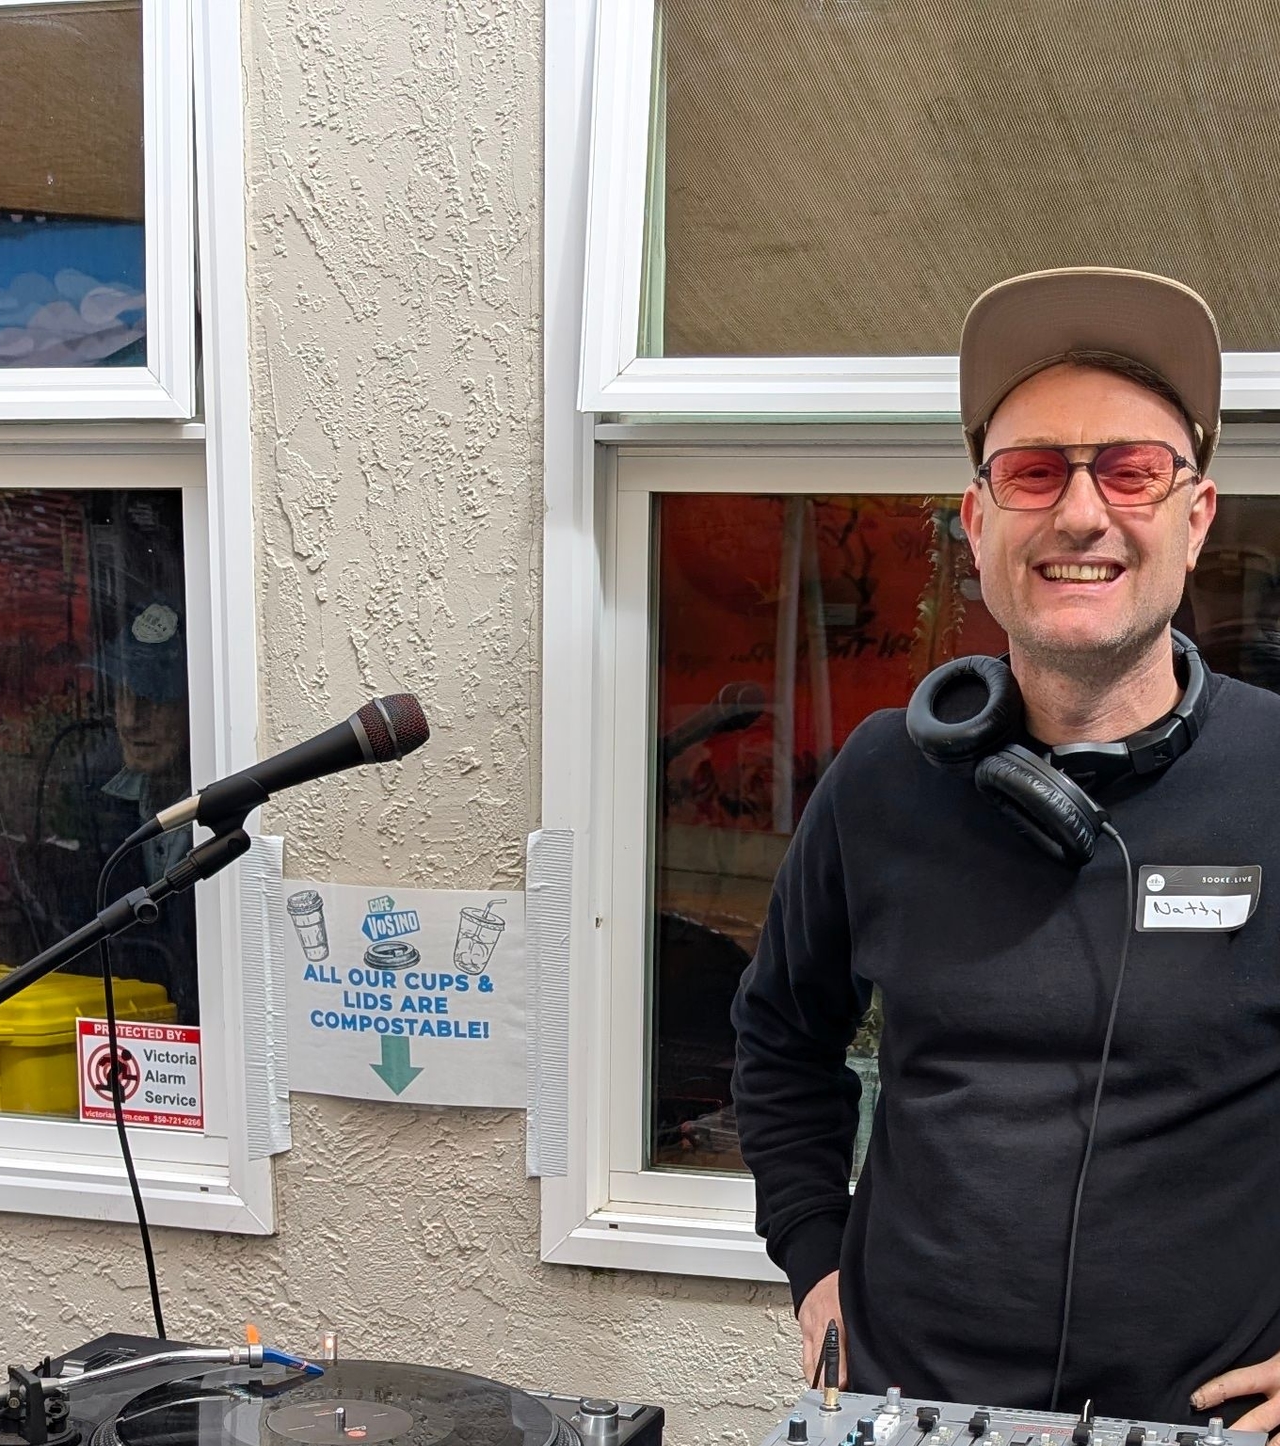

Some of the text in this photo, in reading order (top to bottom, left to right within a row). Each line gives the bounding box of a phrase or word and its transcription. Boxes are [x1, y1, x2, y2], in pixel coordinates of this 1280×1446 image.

[1202, 875, 1253, 884] SOOKE.LIVE
[370, 897, 391, 912] CAFE
[1153, 901, 1222, 925] Natty
[304, 964, 494, 993] ALL OUR CUPS &
[344, 991, 448, 1014] LIDS ARE
[94, 1024, 186, 1041] PRTECTED BY:
[310, 1010, 490, 1039] COMPOSTABLE!
[143, 1049, 197, 1065] Victoria
[145, 1070, 186, 1085] Alarm
[145, 1091, 197, 1107] Service
